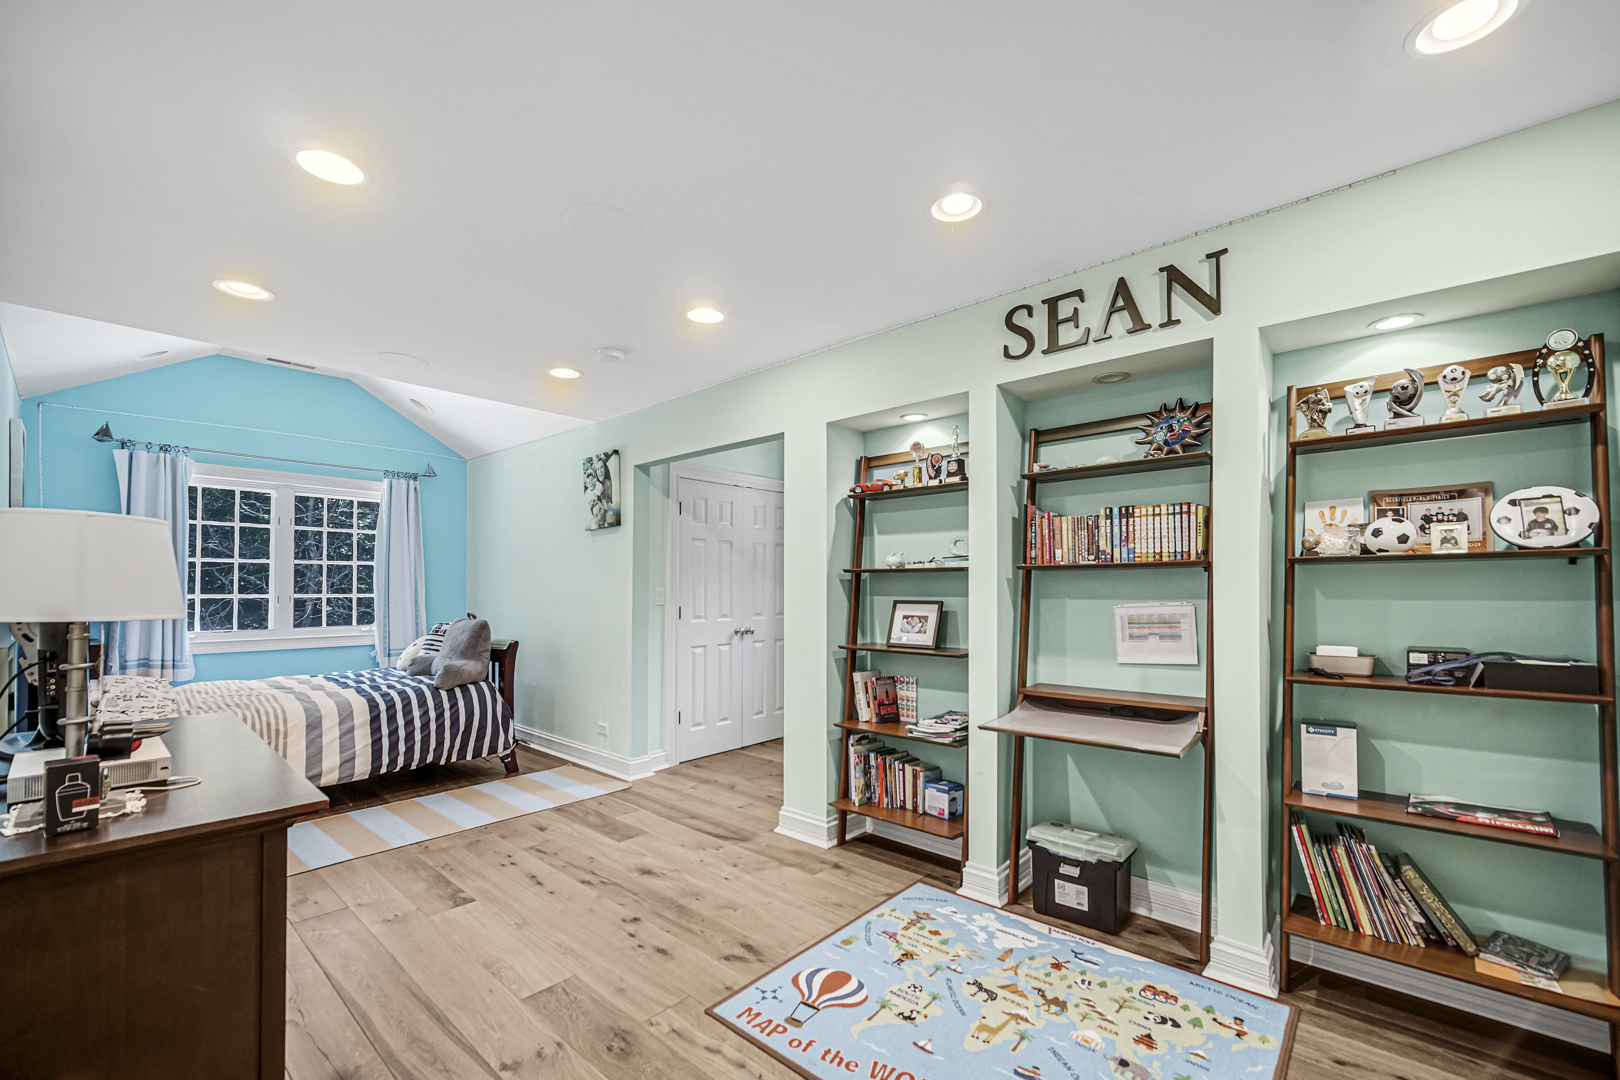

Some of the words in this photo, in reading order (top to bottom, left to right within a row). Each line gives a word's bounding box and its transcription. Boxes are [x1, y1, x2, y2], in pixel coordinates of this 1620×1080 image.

[1003, 248, 1229, 361] SEAN
[1394, 878, 1407, 891] TOP
[995, 928, 1036, 944] GREENLAND
[1052, 929, 1077, 940] NORTH
[1078, 936, 1097, 946] POLE
[900, 933, 921, 944] NORTH
[921, 941, 950, 956] AMERICA
[1025, 973, 1055, 988] EUROPE
[888, 990, 919, 1006] AMERICA
[897, 987, 921, 1001] SOUTH
[1129, 995, 1156, 1008] RUSSIA
[1188, 981, 1223, 996] ARCTIC
[1224, 993, 1259, 1010] OCEAN
[1001, 996, 1029, 1010] AFRICA
[1096, 1024, 1119, 1037] ASIA
[1128, 1019, 1152, 1032] CHINA
[735, 1006, 789, 1038] MAP
[787, 1037, 817, 1053] of
[819, 1048, 859, 1073] the
[1074, 1041, 1096, 1054] INDIA
[1183, 1058, 1210, 1073] JAPAN
